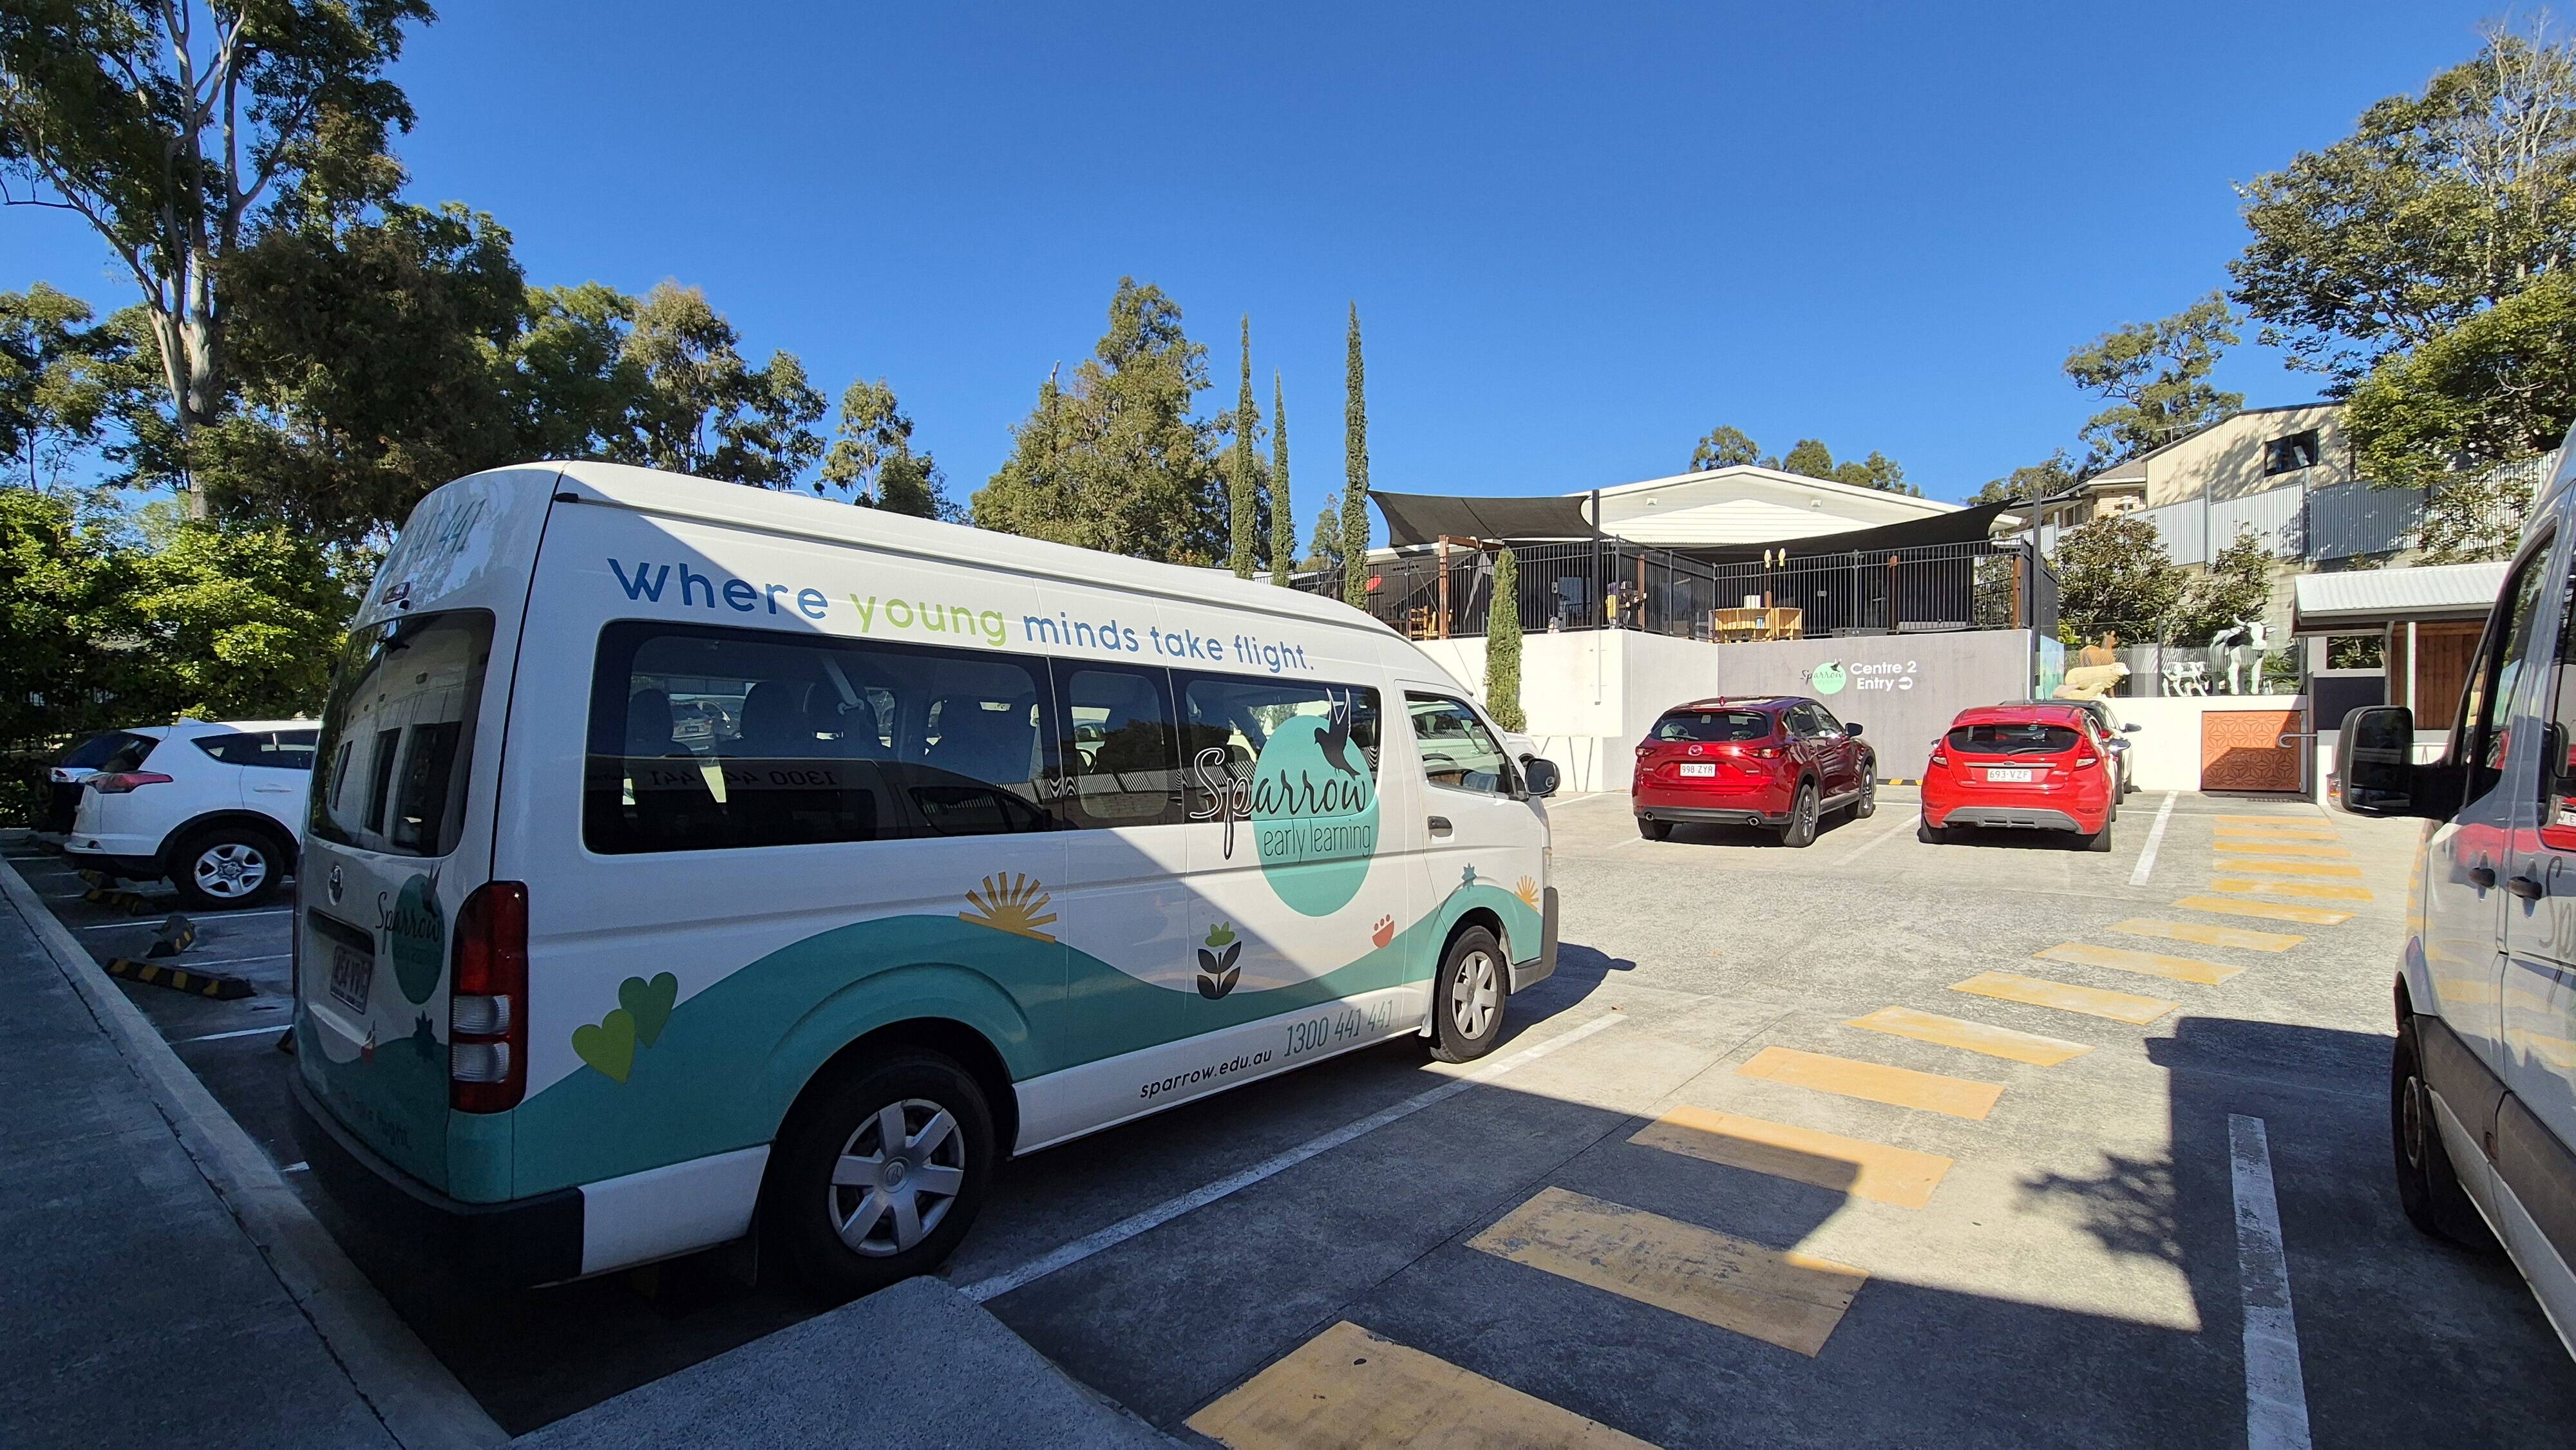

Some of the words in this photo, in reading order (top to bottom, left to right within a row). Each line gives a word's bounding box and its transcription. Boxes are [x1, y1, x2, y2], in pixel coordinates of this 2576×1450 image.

[607, 558, 828, 619] where
[849, 593, 1007, 647] young
[1023, 612, 1139, 652] minds
[1150, 626, 1223, 661] take
[1233, 634, 1314, 673] flight.
[1850, 661, 1903, 675] Centre
[1907, 661, 1917, 673] 2
[1857, 677, 1895, 692] Entry
[1189, 747, 1368, 860] Sparrow
[1264, 818, 1306, 864] early
[1309, 818, 1371, 857] learning
[375, 892, 440, 955] Sparrow
[1140, 1049, 1273, 1099] sparrow.edu.au
[1283, 1016, 1329, 1057] 1300
[1334, 1008, 1363, 1042] 441
[1367, 999, 1394, 1031] 441
